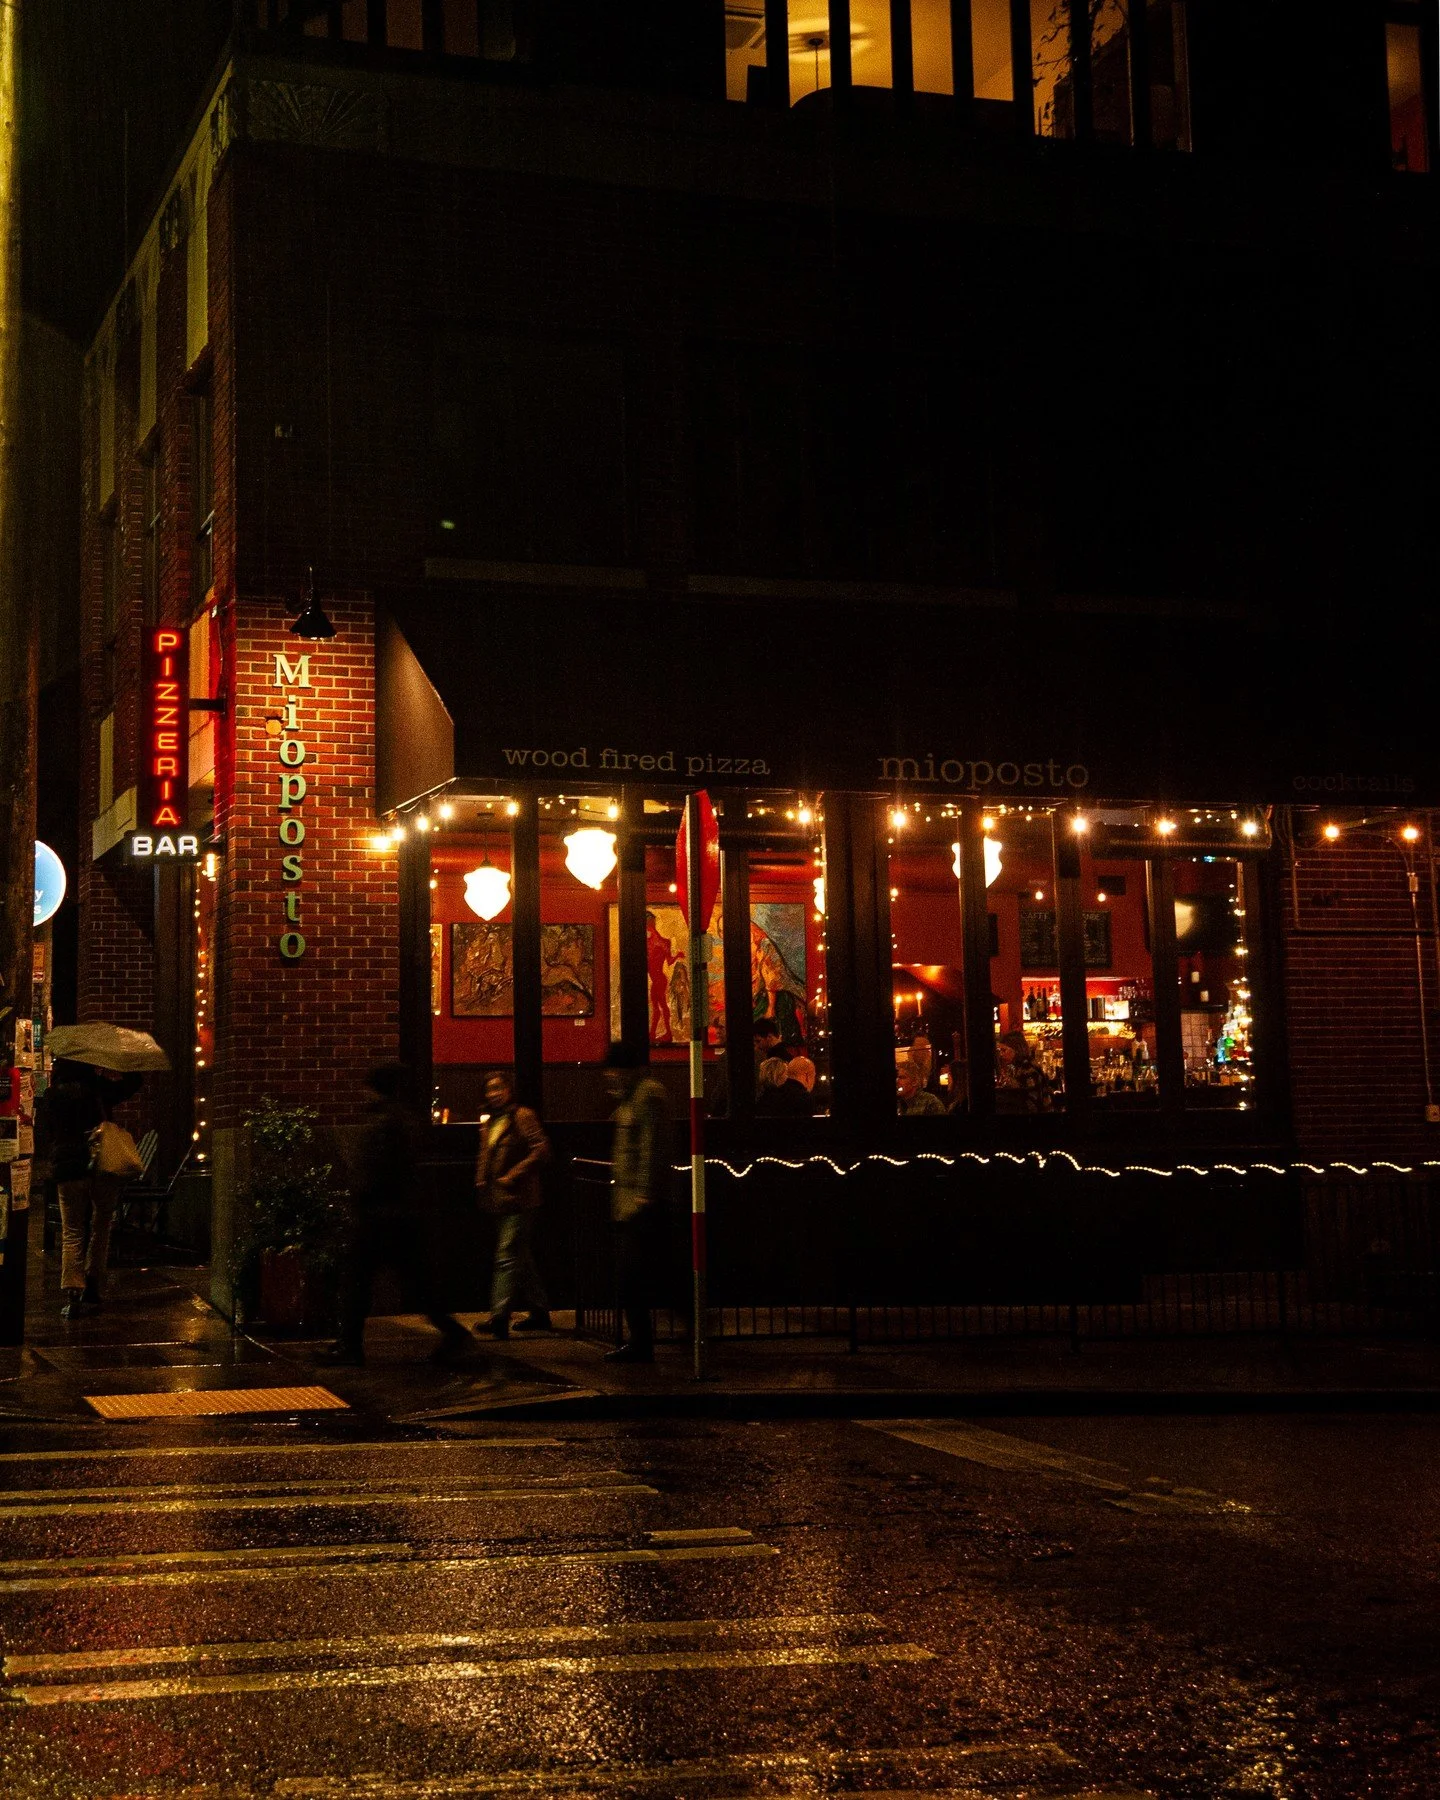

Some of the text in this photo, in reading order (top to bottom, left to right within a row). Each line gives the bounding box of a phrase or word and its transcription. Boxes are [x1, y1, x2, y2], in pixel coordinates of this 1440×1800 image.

[154, 632, 181, 827] PIZZERIA
[501, 747, 771, 777] wood fired pizza
[877, 753, 1090, 791] mioposto
[1292, 772, 1416, 793] cocktails
[272, 653, 312, 959] Mioposto
[132, 835, 199, 856] BAR
